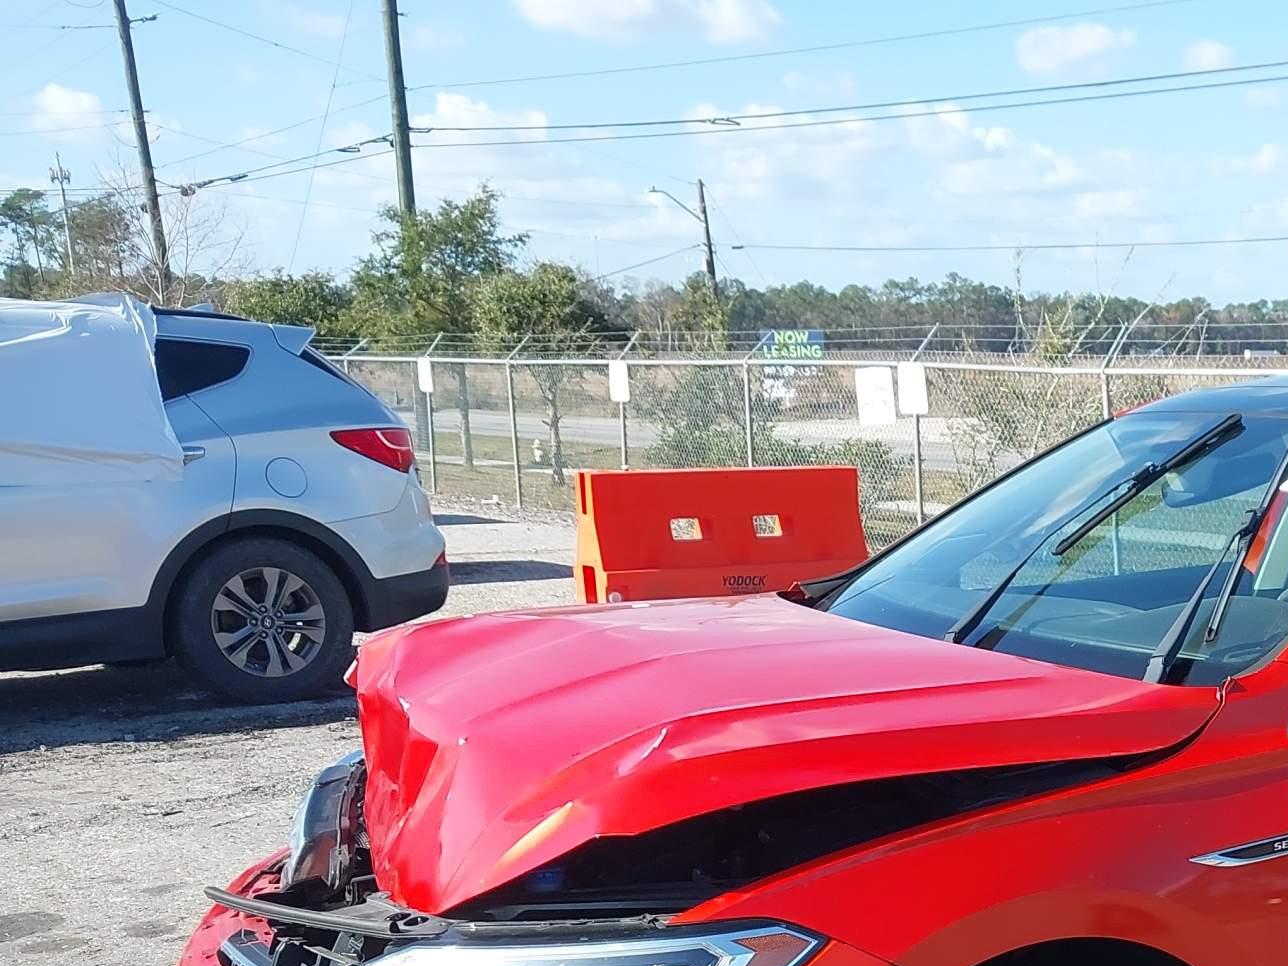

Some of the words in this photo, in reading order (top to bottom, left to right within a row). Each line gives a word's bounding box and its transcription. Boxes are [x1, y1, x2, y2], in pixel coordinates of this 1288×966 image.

[773, 329, 809, 344] NOW
[763, 344, 822, 358] LEASING
[722, 575, 766, 587] YODOCK
